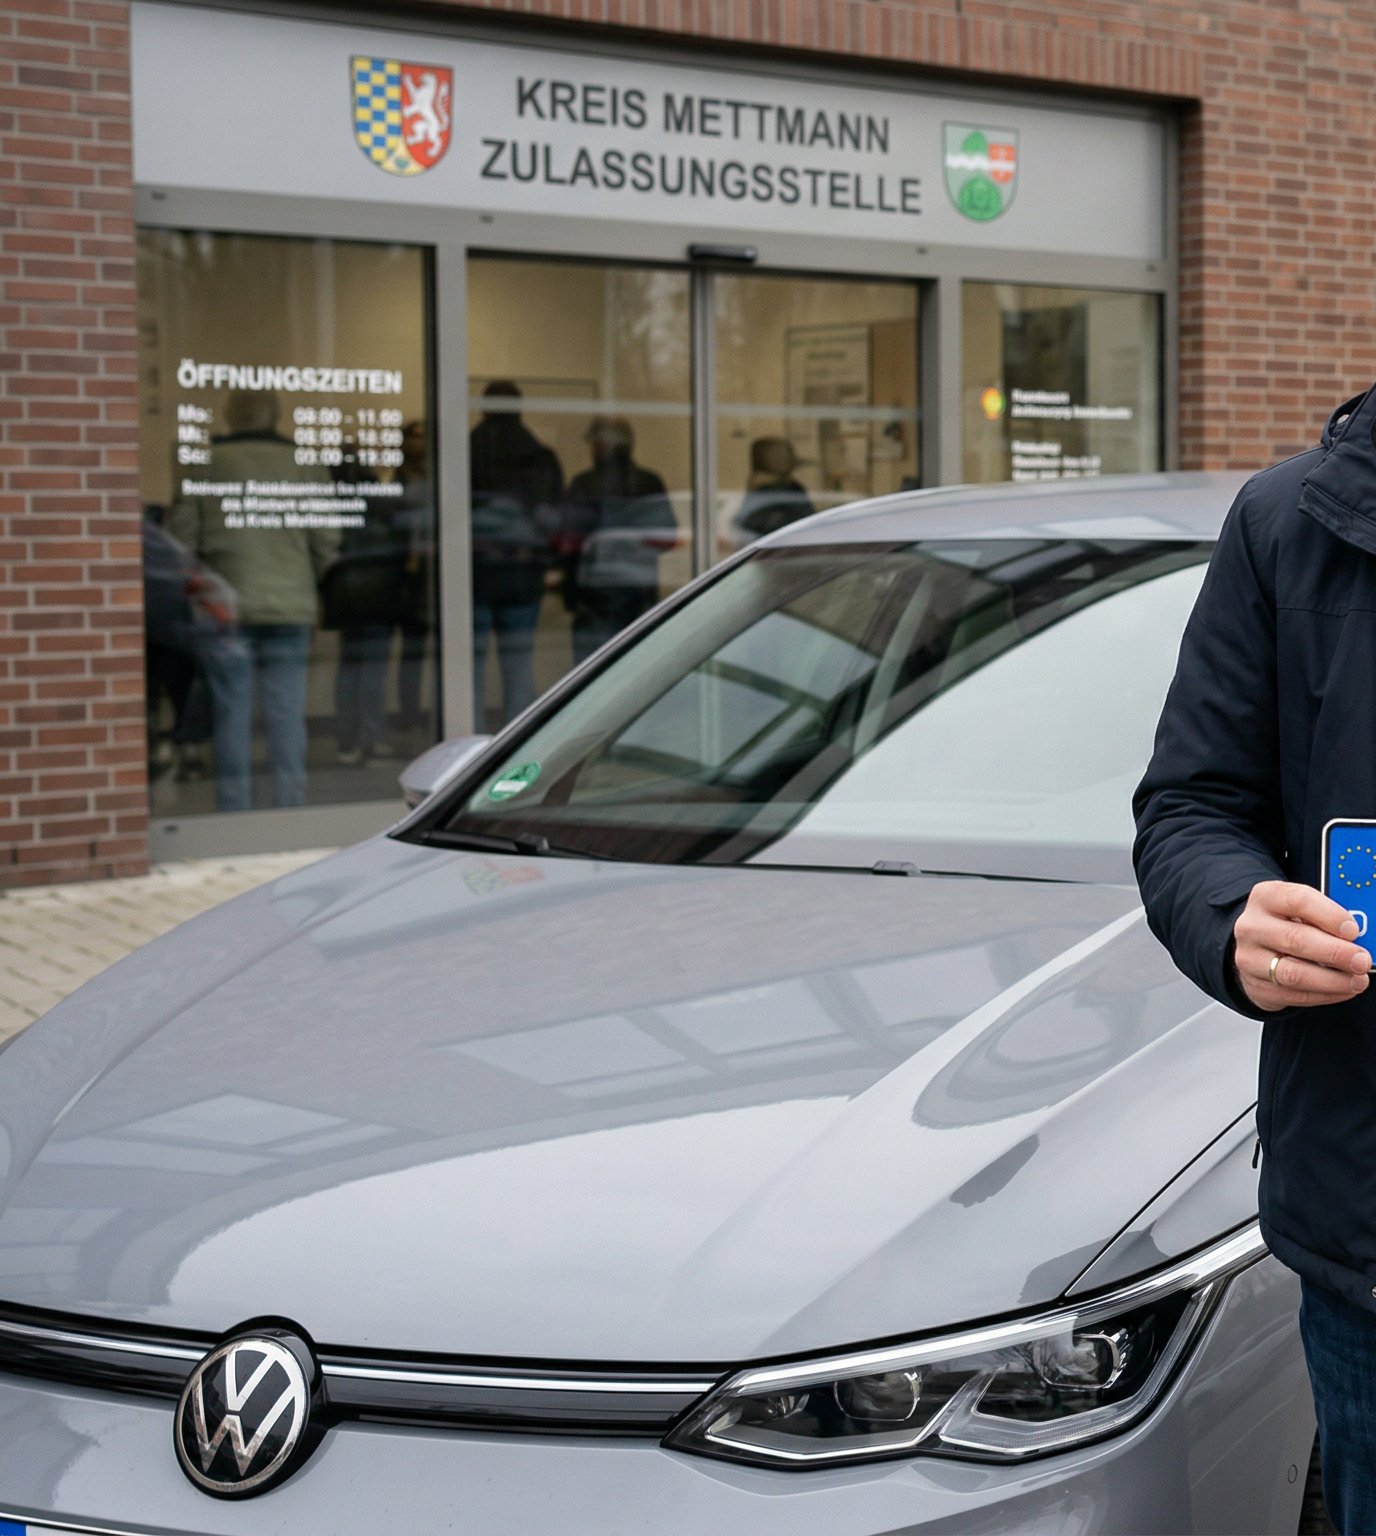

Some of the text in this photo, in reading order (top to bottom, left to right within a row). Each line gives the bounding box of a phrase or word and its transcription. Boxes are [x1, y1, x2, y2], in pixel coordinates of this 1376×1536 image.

[516, 77, 890, 154] KREIS METTMANN
[481, 139, 922, 215] ZULASSUNGSSTELLE
[177, 359, 403, 394] ÖFFNUNGSZEITEN
